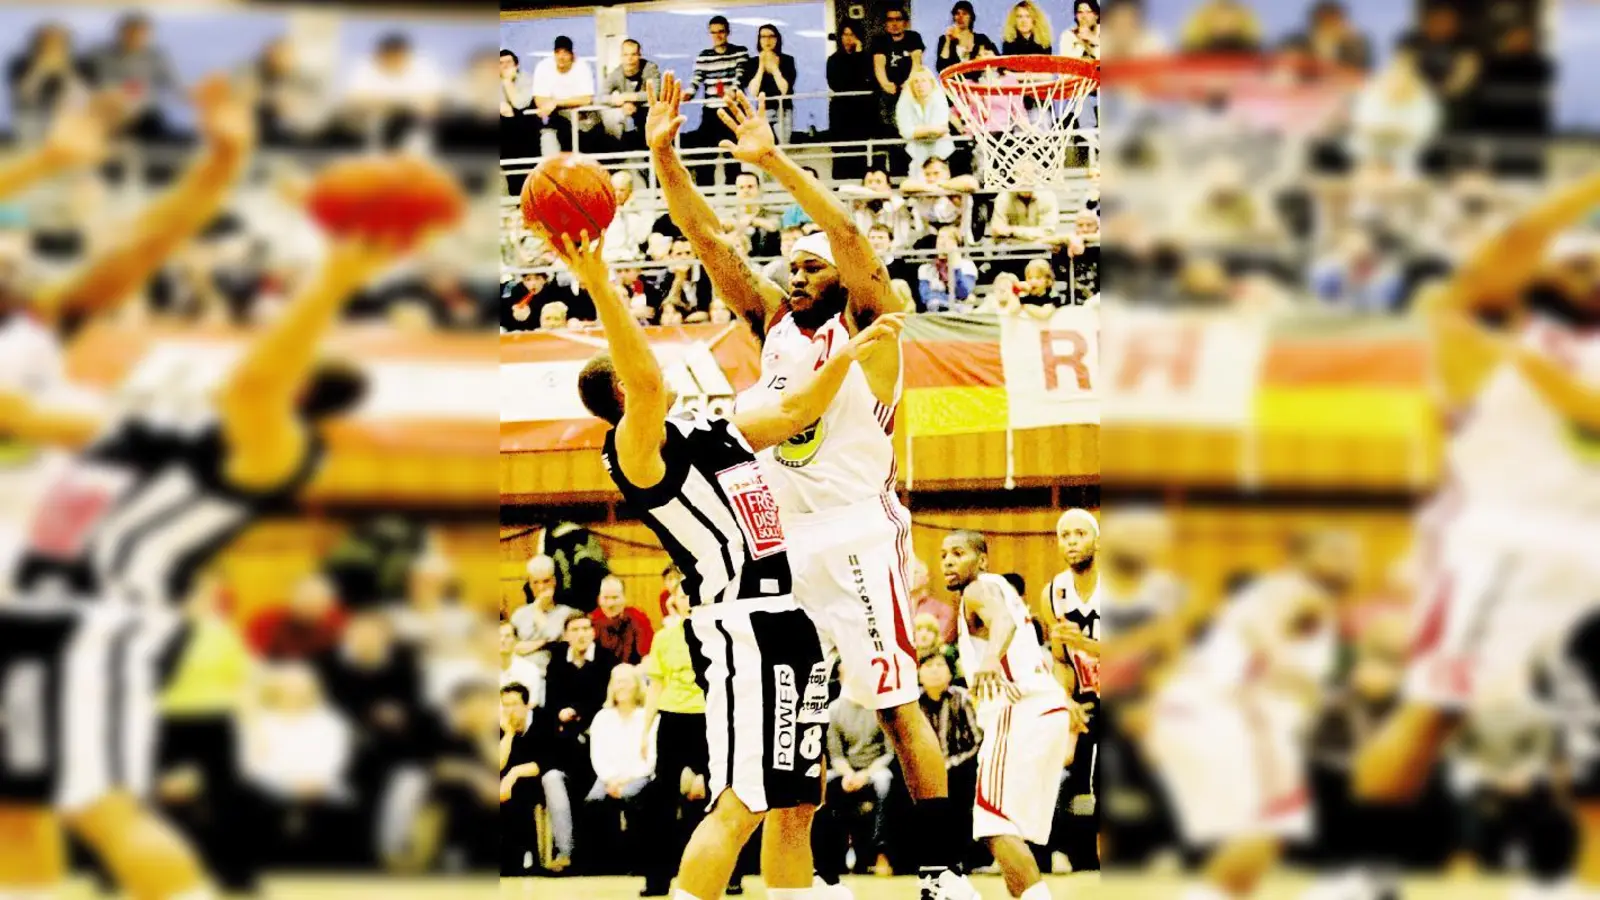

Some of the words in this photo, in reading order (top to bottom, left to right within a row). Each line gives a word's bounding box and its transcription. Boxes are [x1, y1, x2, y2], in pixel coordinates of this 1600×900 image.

[1040, 329, 1100, 392] R
[871, 652, 901, 695] 21
[778, 670, 792, 766] POWER
